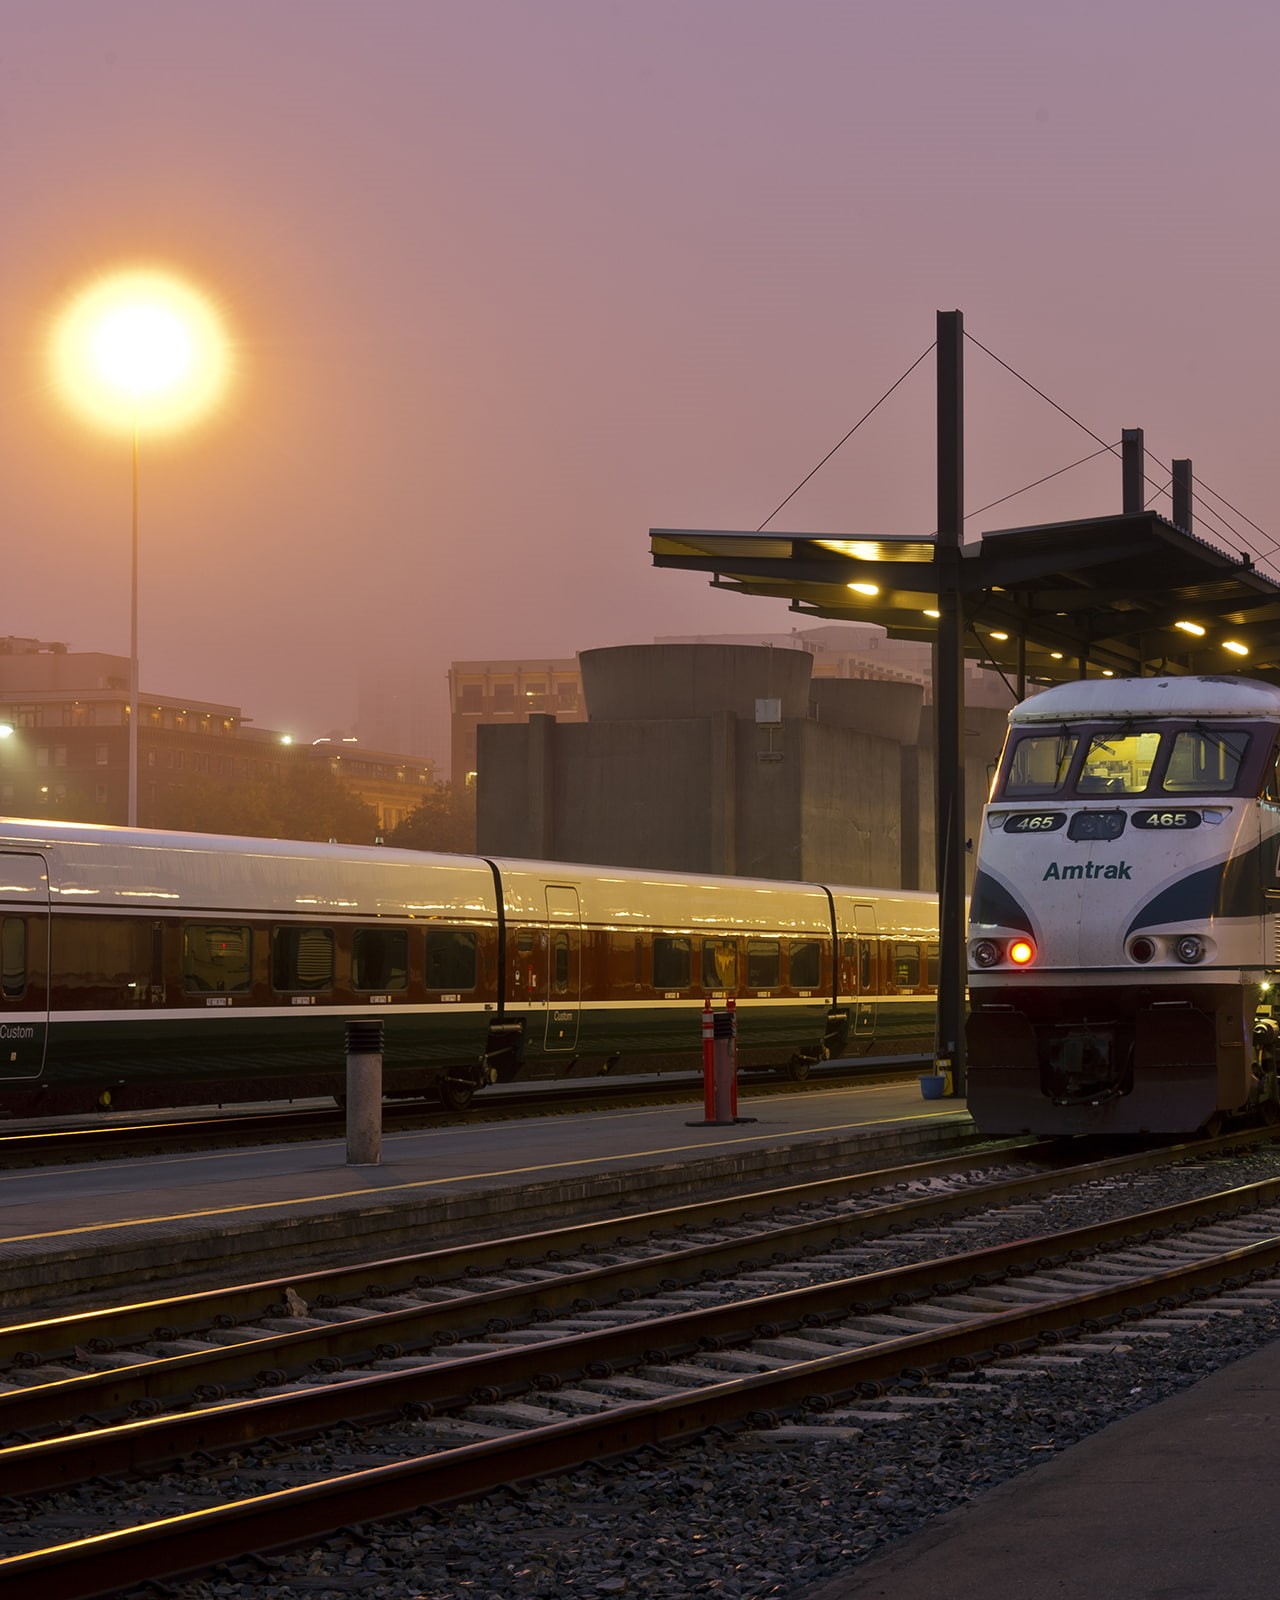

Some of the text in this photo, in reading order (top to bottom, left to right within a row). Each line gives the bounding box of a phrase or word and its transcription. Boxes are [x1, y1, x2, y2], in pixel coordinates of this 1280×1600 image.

[1016, 816, 1054, 830] 465
[1146, 813, 1187, 826] 465
[1042, 861, 1133, 881] Amtrak
[0, 1024, 34, 1039] Custom
